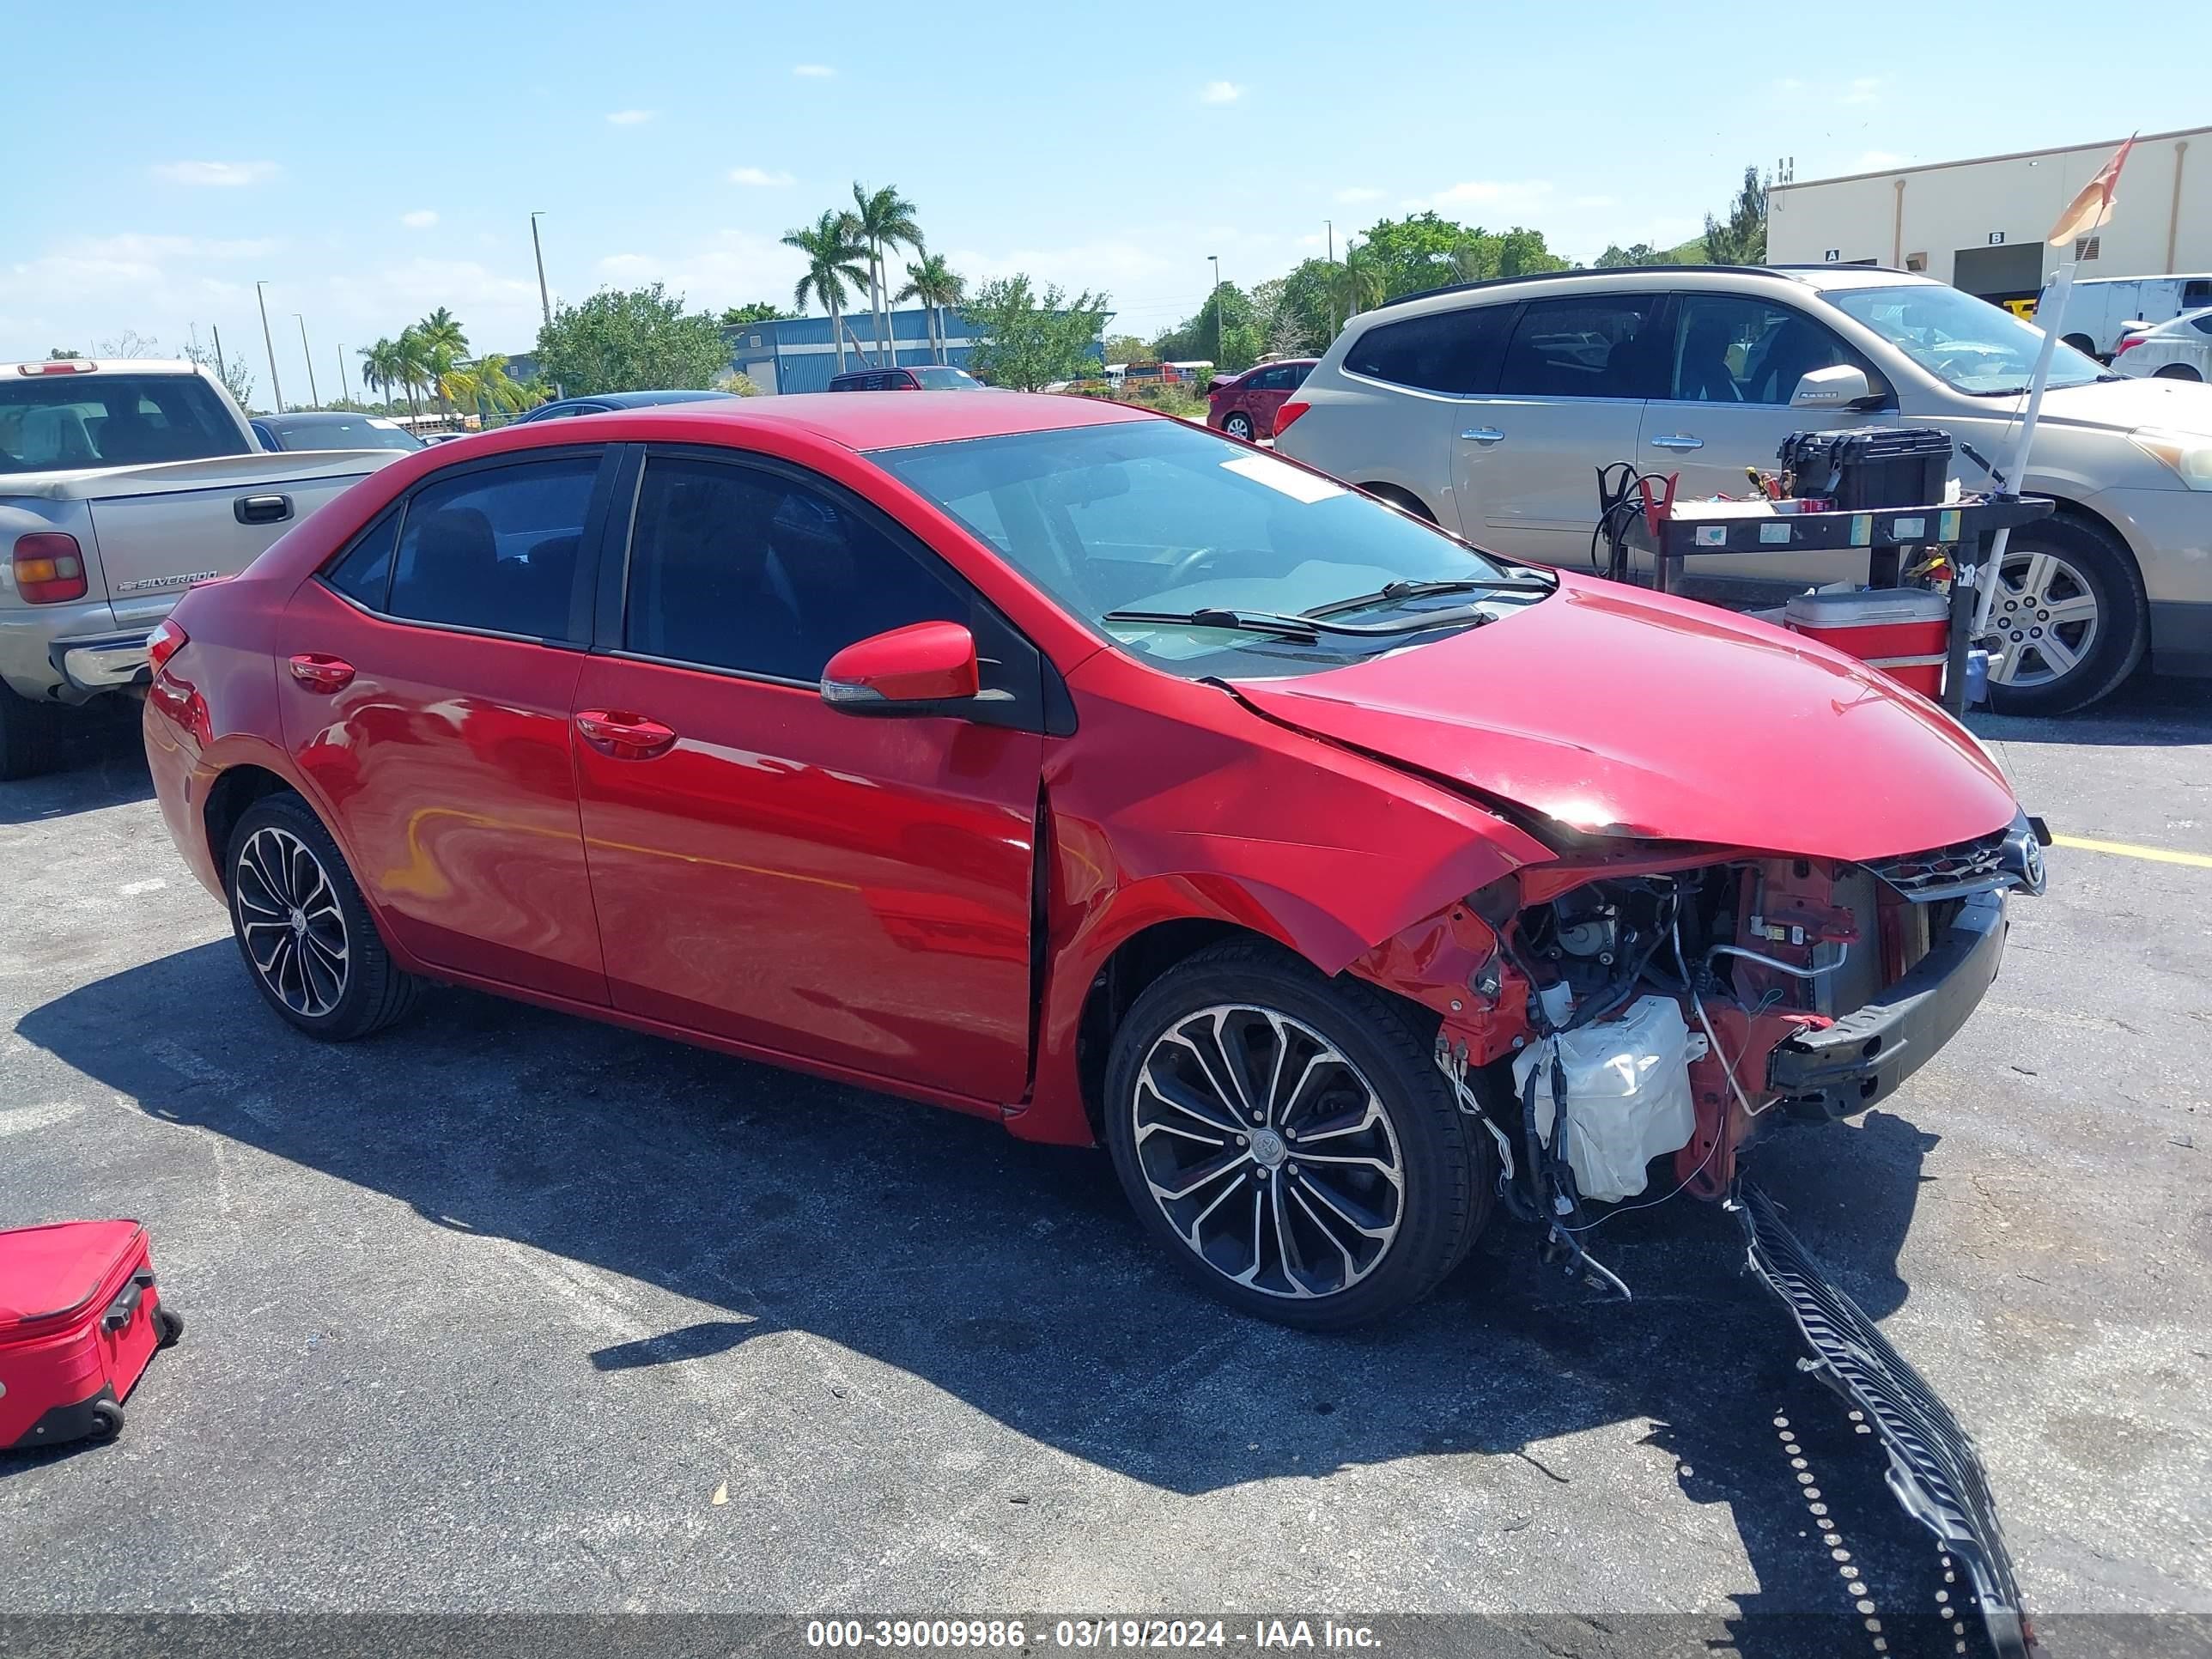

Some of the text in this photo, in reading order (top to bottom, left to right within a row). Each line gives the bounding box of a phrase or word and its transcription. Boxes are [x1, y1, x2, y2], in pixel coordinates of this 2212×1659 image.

[1990, 233, 2002, 244] B
[1827, 251, 1838, 261] A
[137, 570, 218, 589] SILVERADO
